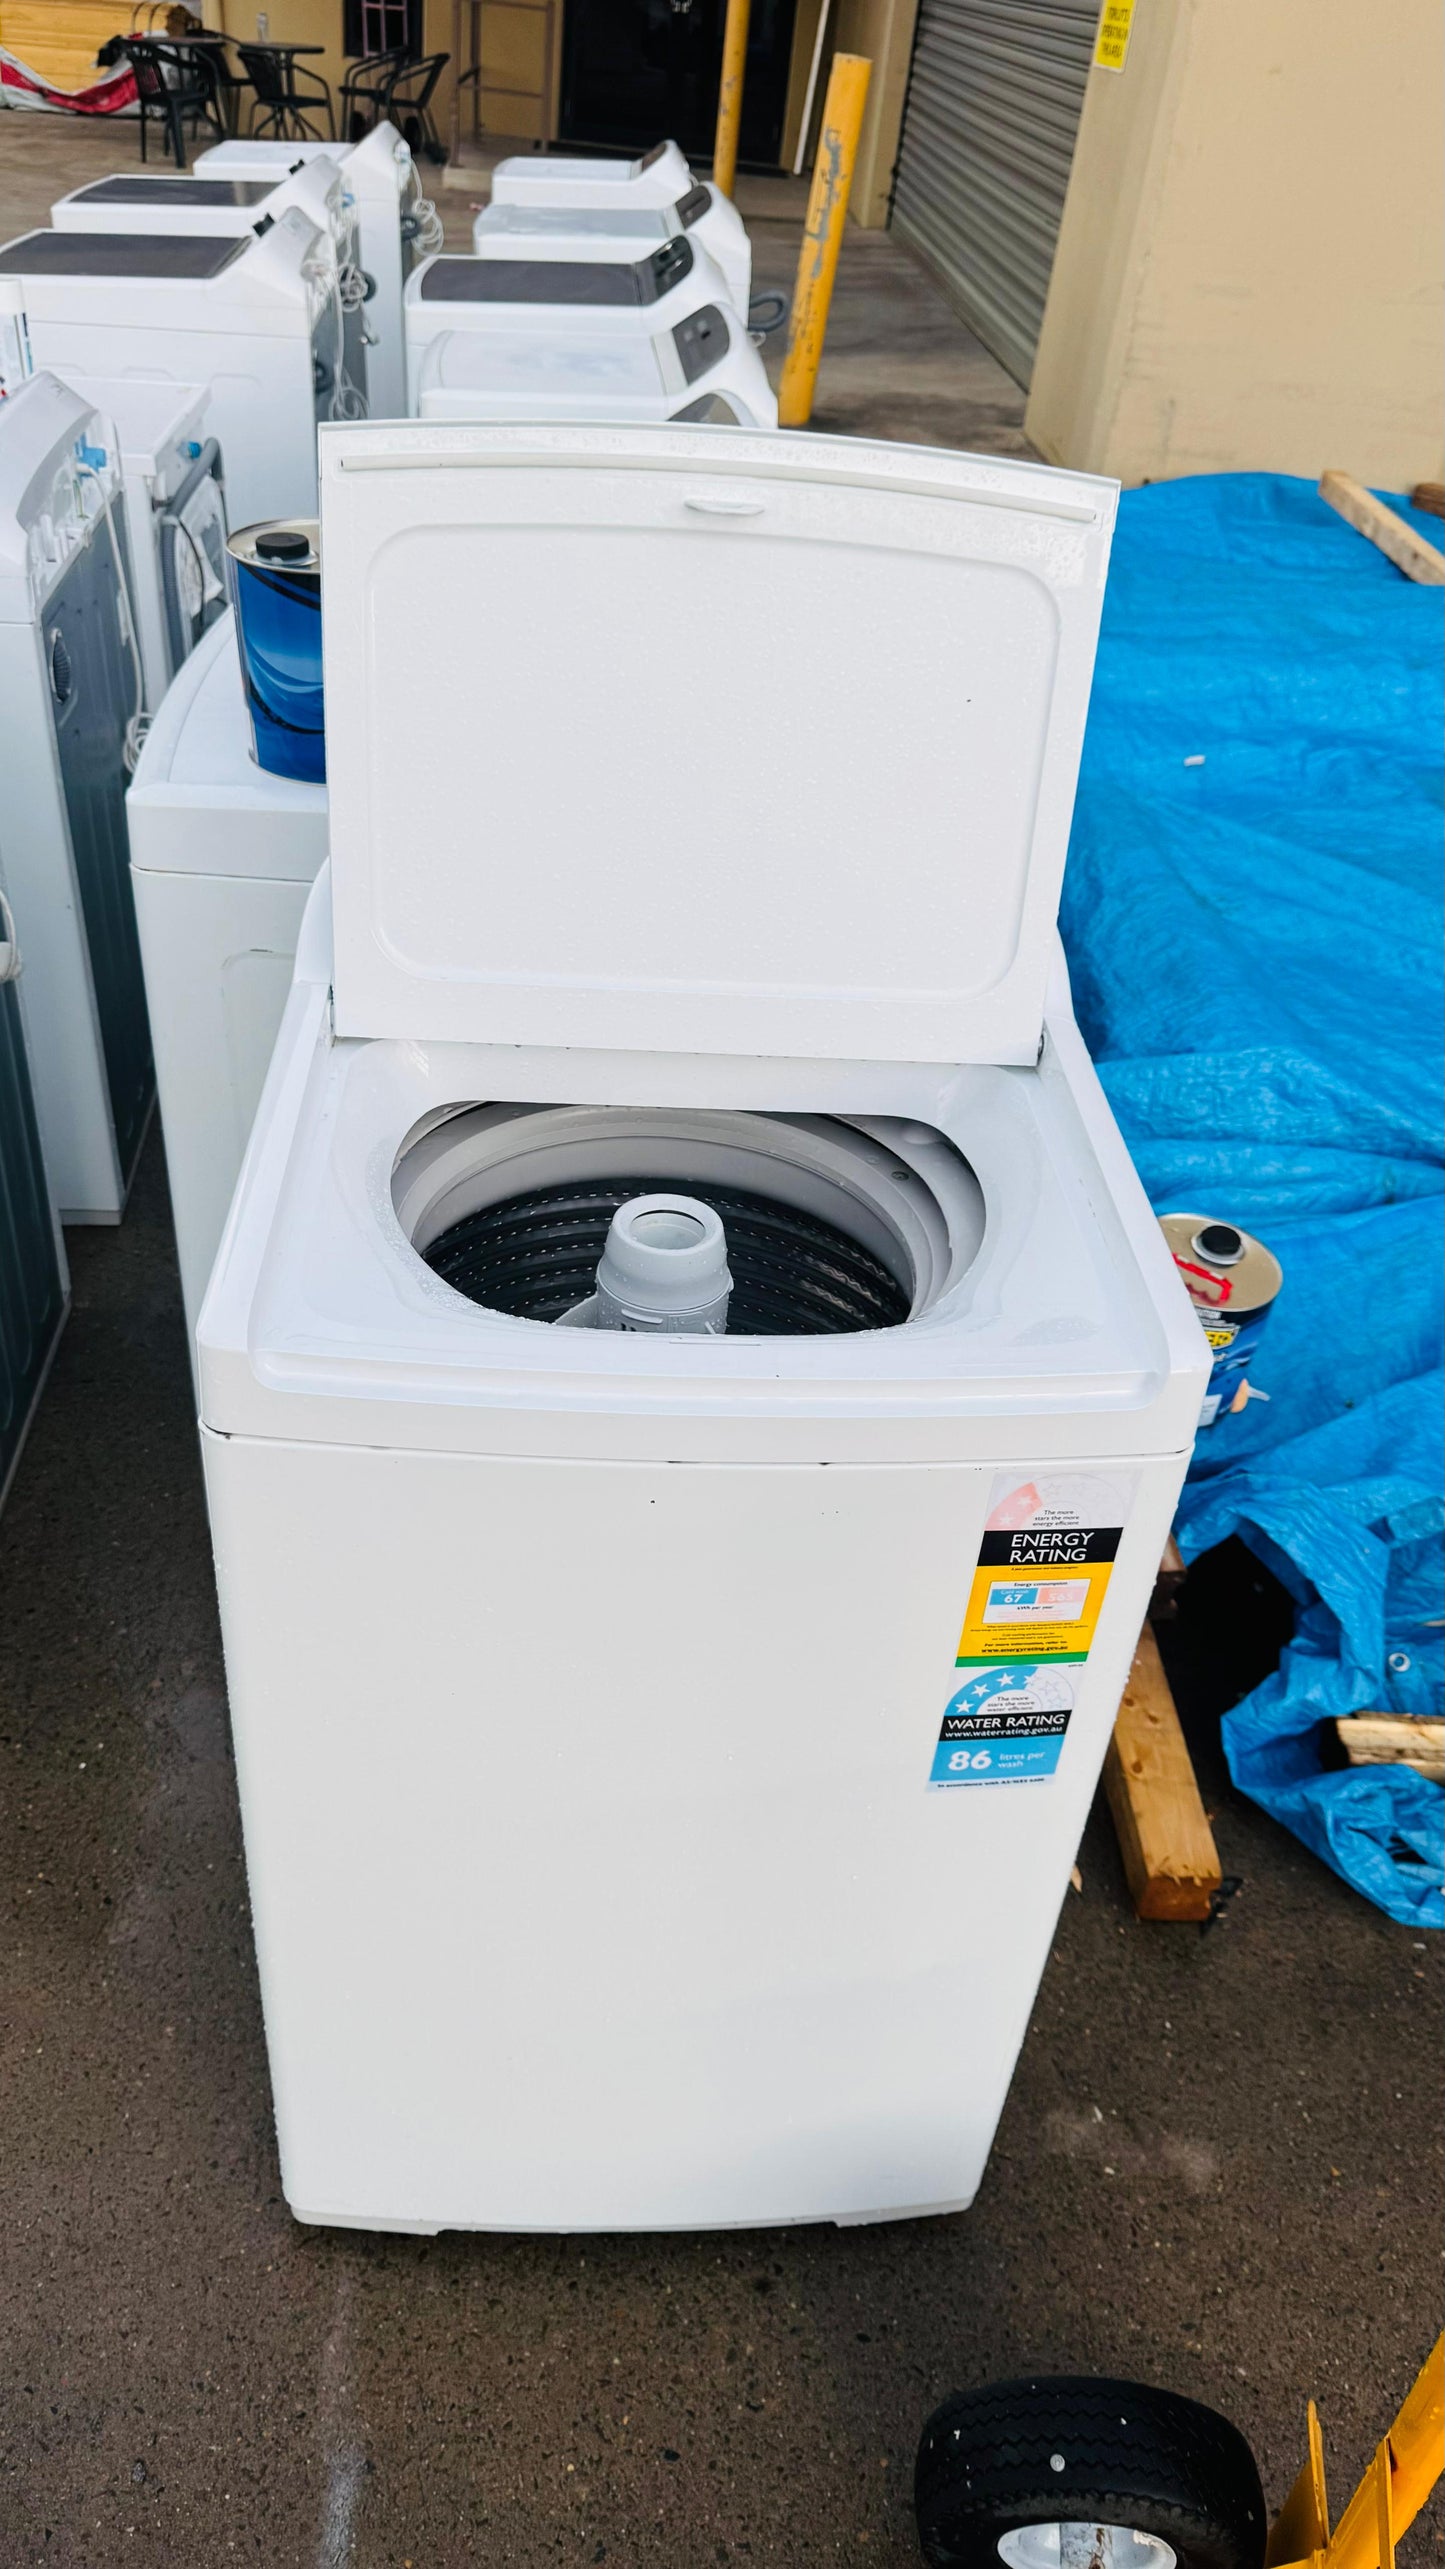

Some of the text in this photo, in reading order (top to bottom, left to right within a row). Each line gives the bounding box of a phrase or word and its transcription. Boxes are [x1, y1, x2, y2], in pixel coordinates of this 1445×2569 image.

[1011, 1532, 1095, 1548] ENERGY
[1009, 1548, 1088, 1563] RATING
[1004, 1594, 1024, 1604] 67
[947, 1714, 1066, 1729] WATER RATING
[945, 1726, 1063, 1738] www.waterrating.gov.au
[948, 1750, 1046, 1771] 86 litres per
[998, 1761, 1024, 1769] wash
